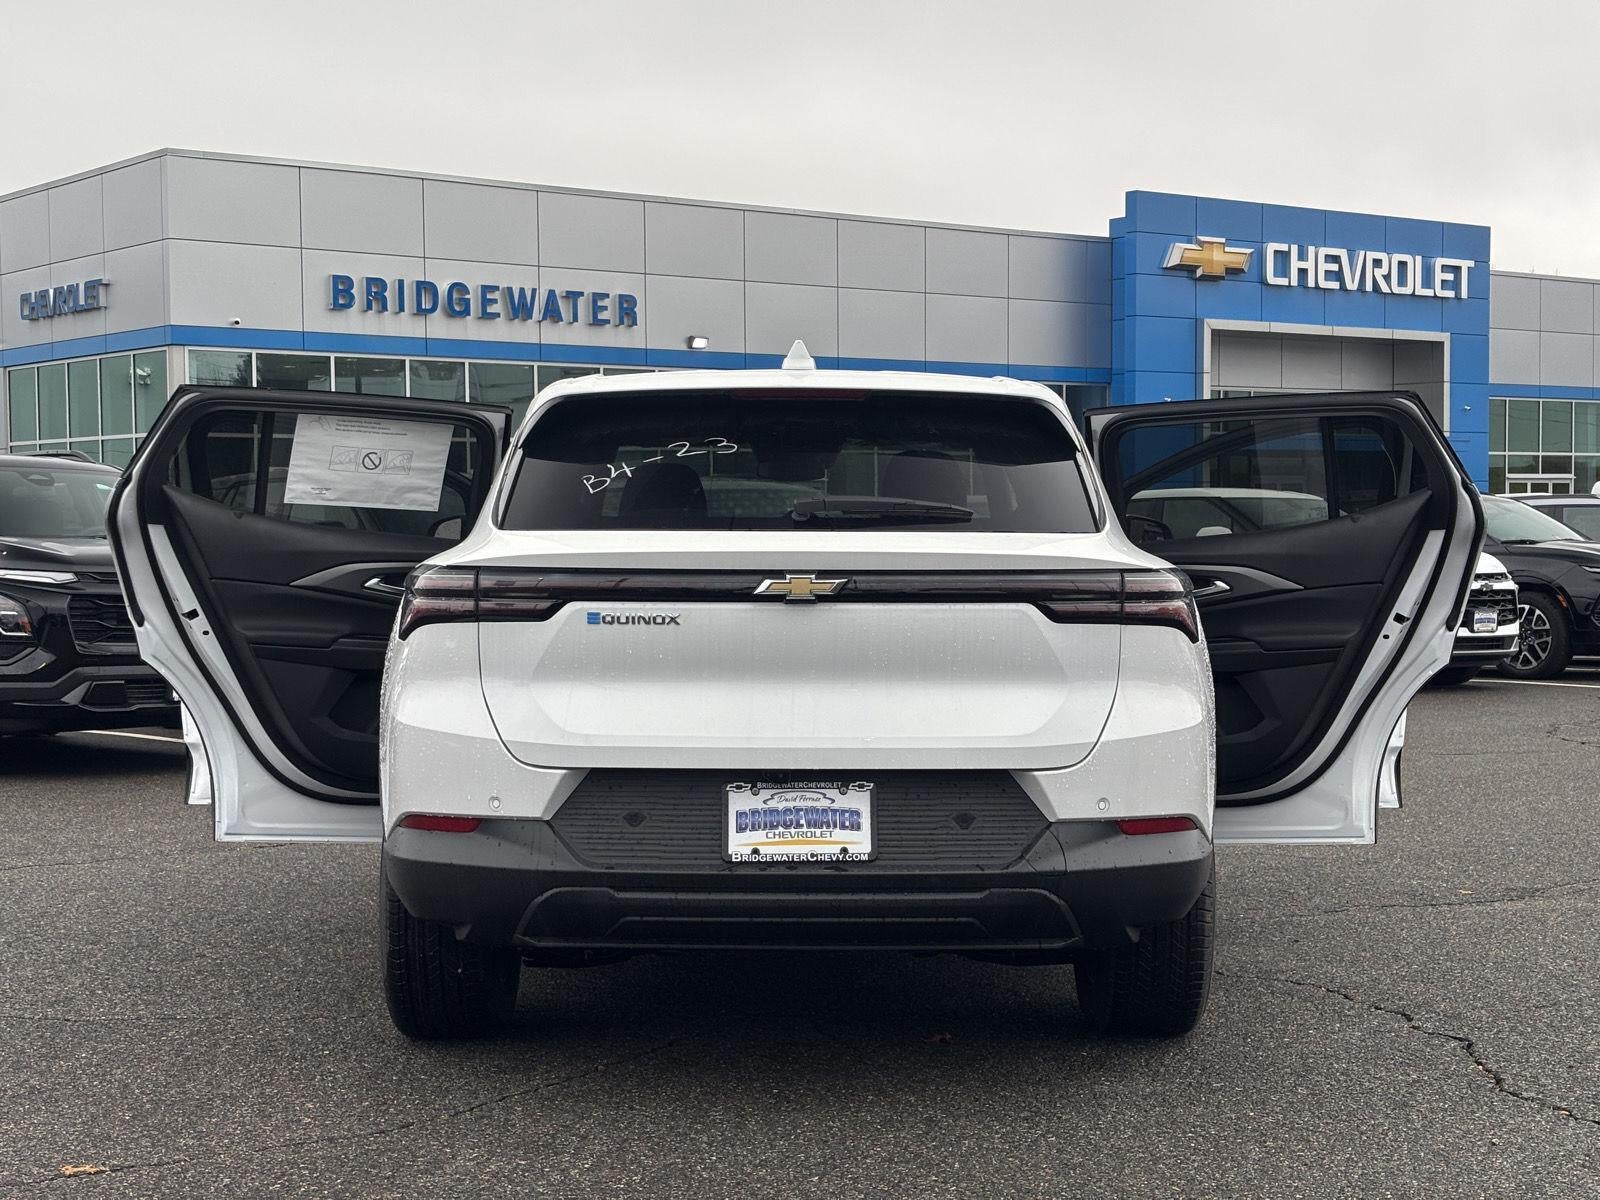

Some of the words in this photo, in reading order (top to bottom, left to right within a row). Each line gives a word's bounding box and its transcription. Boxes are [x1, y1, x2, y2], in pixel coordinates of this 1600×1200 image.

[1264, 242, 1475, 299] CHEVROLET
[329, 273, 639, 327] BRIDGEWATER
[586, 611, 681, 626] EQUINOX
[735, 805, 863, 834] BRIDGEWATER
[765, 830, 834, 839] CHEVROLET
